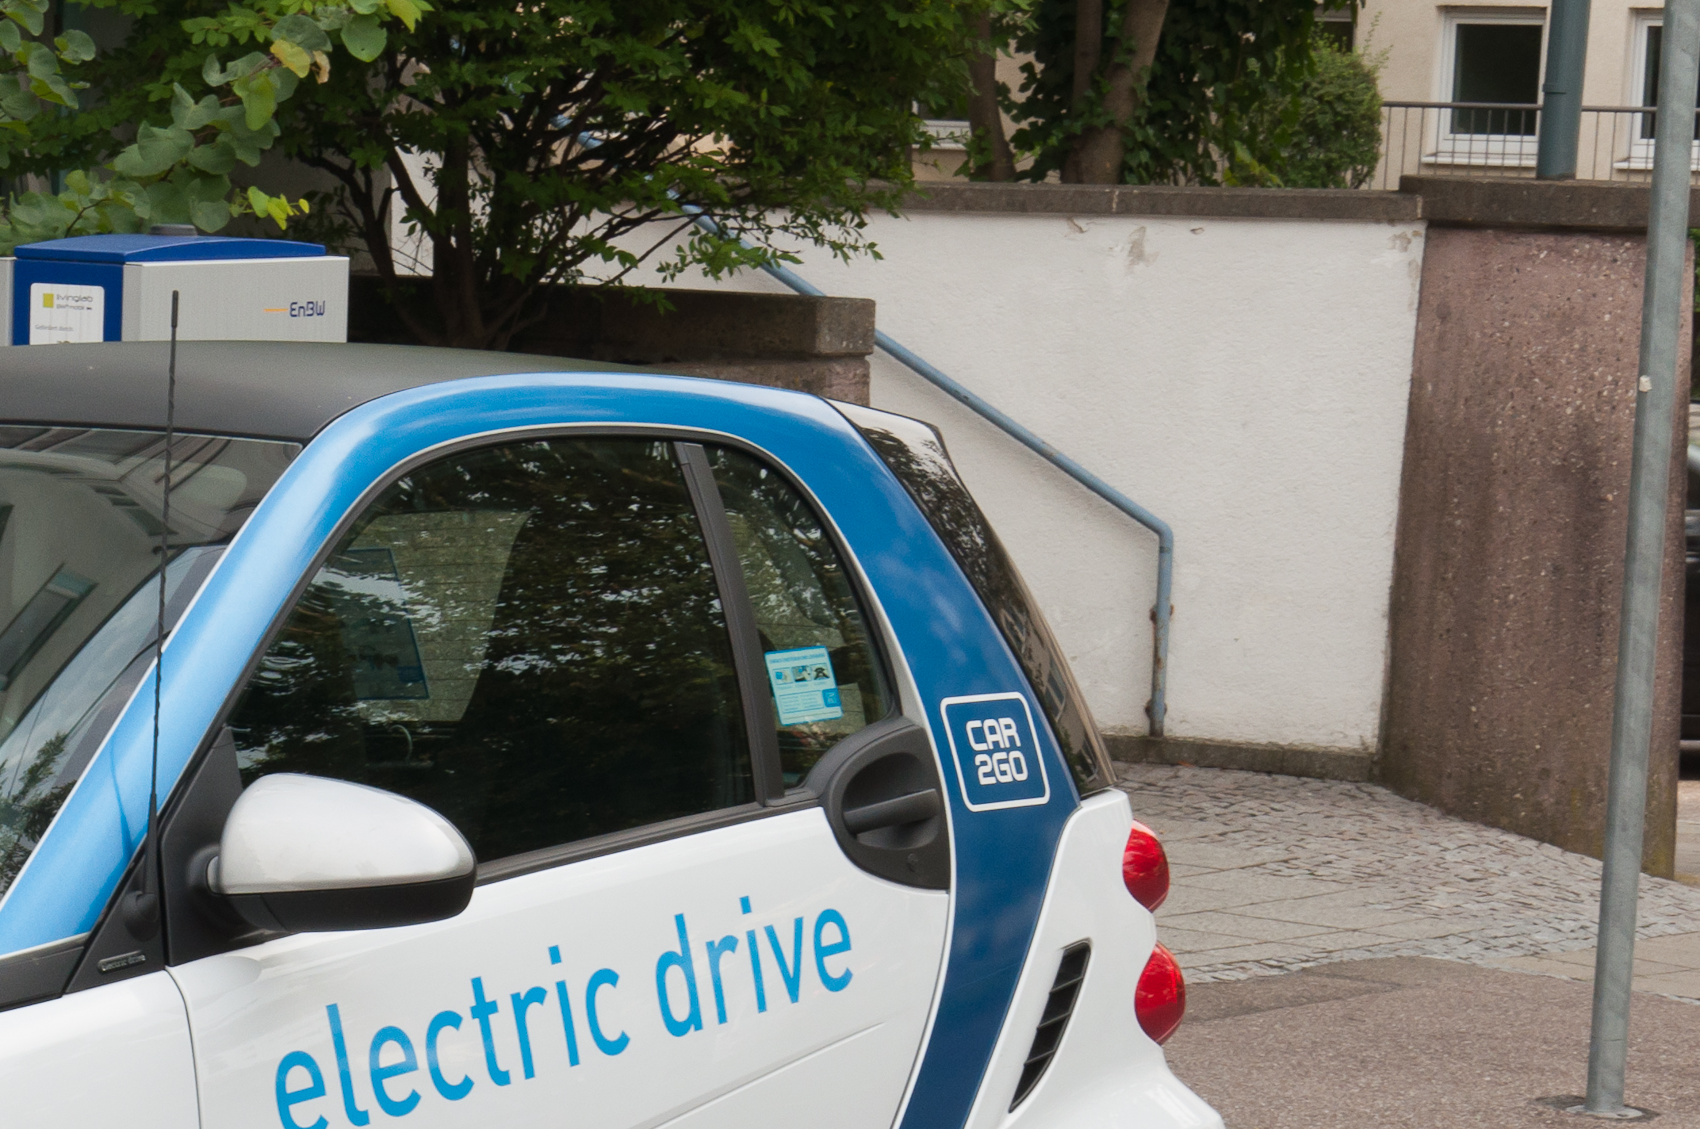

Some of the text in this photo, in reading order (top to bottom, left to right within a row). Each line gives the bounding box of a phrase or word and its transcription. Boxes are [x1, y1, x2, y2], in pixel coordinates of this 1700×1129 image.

[289, 300, 326, 317] EnBW
[965, 717, 1021, 751] CAR
[974, 750, 1029, 786] 2GO
[655, 896, 853, 1038] drive
